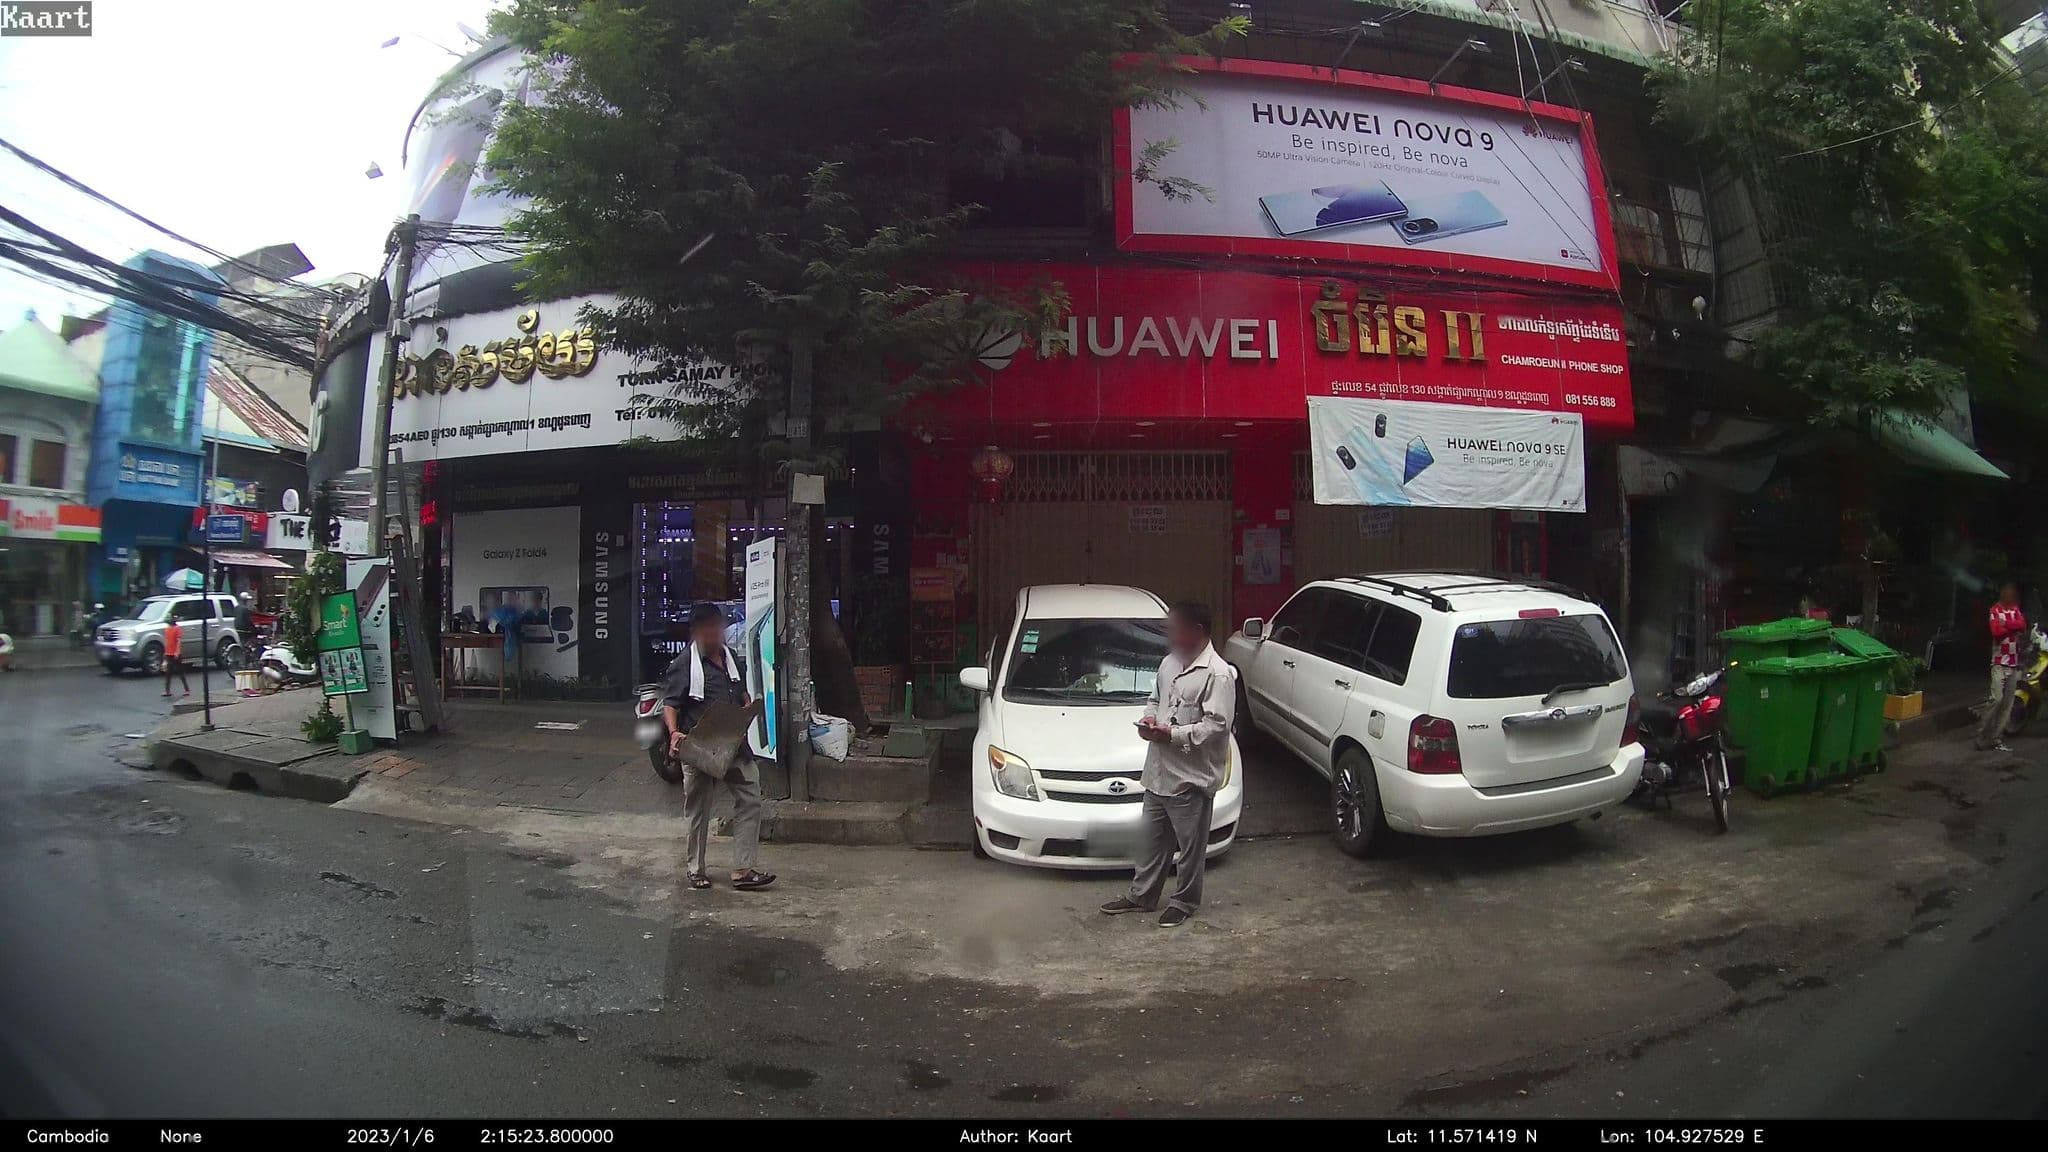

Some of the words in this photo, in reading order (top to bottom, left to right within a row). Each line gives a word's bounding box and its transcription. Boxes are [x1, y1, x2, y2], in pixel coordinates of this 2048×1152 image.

[1252, 102, 1381, 135] HUAWEI
[1394, 119, 1473, 148] nova
[1480, 132, 1494, 151] 9
[1291, 134, 1314, 149] Be
[1321, 138, 1396, 161] inspired,
[1402, 146, 1425, 161] Be
[1430, 152, 1468, 168] nova
[1040, 316, 1279, 359] HUAWEI
[1501, 354, 1560, 369] CHAMROEUN
[1569, 360, 1599, 372] PHONE
[1600, 363, 1624, 375] SHOP
[666, 365, 726, 383] SAMAY
[1364, 382, 1376, 393] 54
[1410, 385, 1425, 395] 130
[1565, 393, 1580, 405] 081
[1582, 394, 1598, 406] 556
[1600, 395, 1616, 408] 888
[1447, 438, 1502, 452] HUAWEI
[1507, 441, 1541, 453] nova
[1545, 443, 1552, 455] 9
[1553, 444, 1566, 455] SE
[1463, 453, 1475, 463] Be
[1519, 456, 1530, 467] Be
[483, 549, 514, 561] Galaxy
[595, 531, 609, 640] SAMSUNG
[323, 617, 348, 631] Smart
